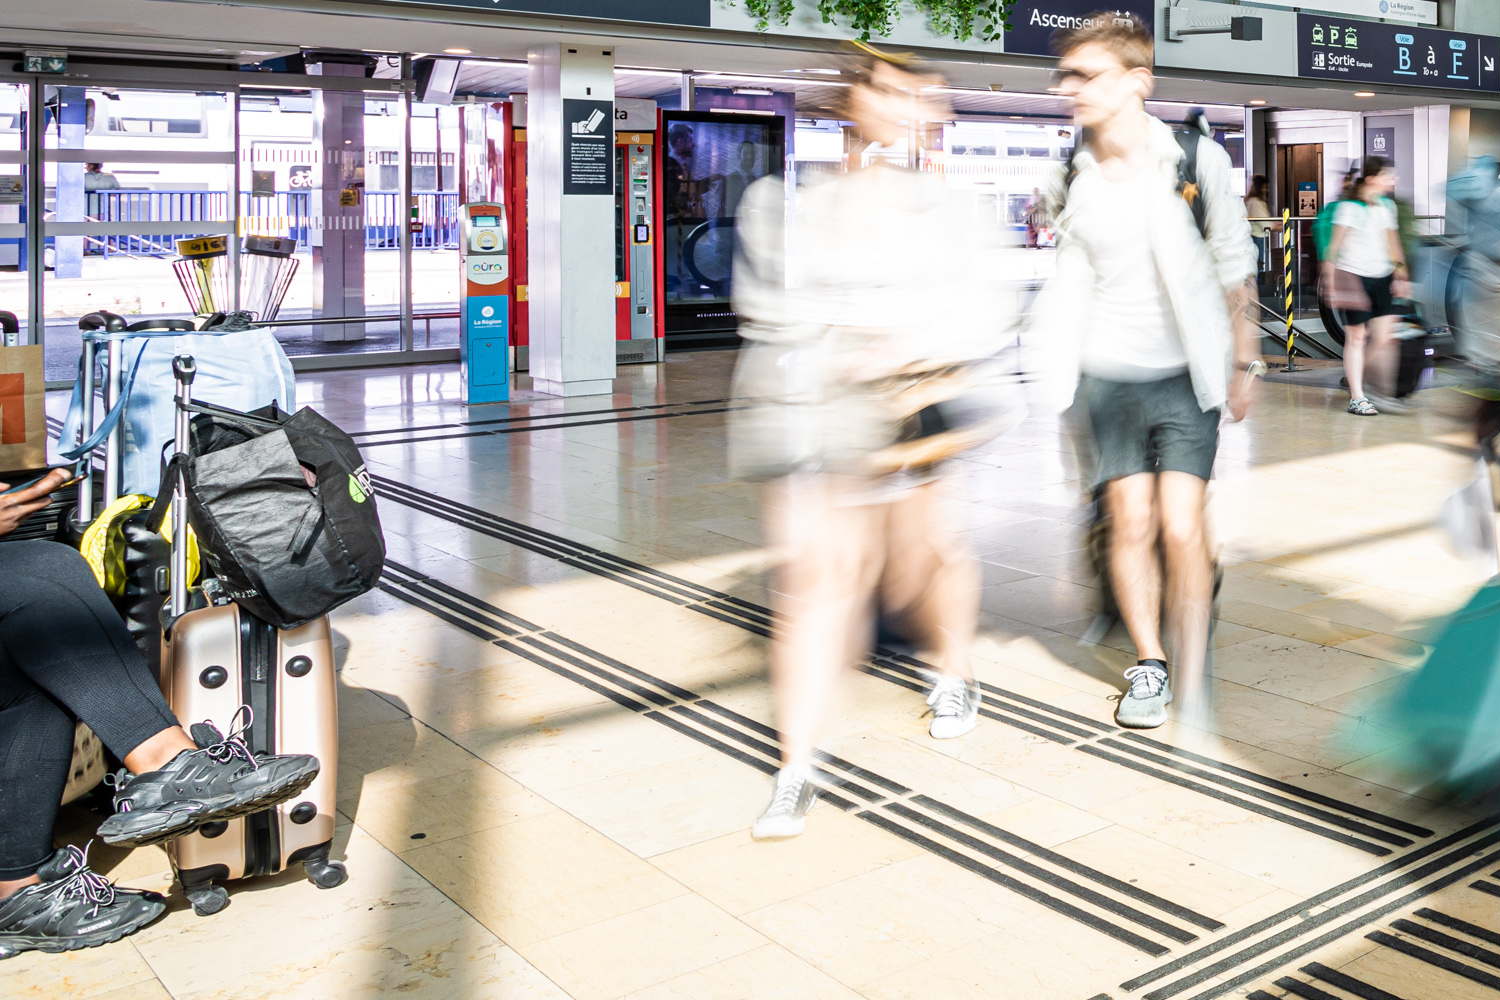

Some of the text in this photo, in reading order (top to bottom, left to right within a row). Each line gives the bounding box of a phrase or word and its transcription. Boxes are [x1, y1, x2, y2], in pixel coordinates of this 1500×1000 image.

[1030, 8, 1105, 30] Ascenseur
[1330, 29, 1339, 44] P
[1328, 52, 1356, 66] Sortie
[1399, 46, 1462, 74] B à F
[1423, 67, 1430, 76] To
[77, 920, 112, 935] BALENCIAGA
